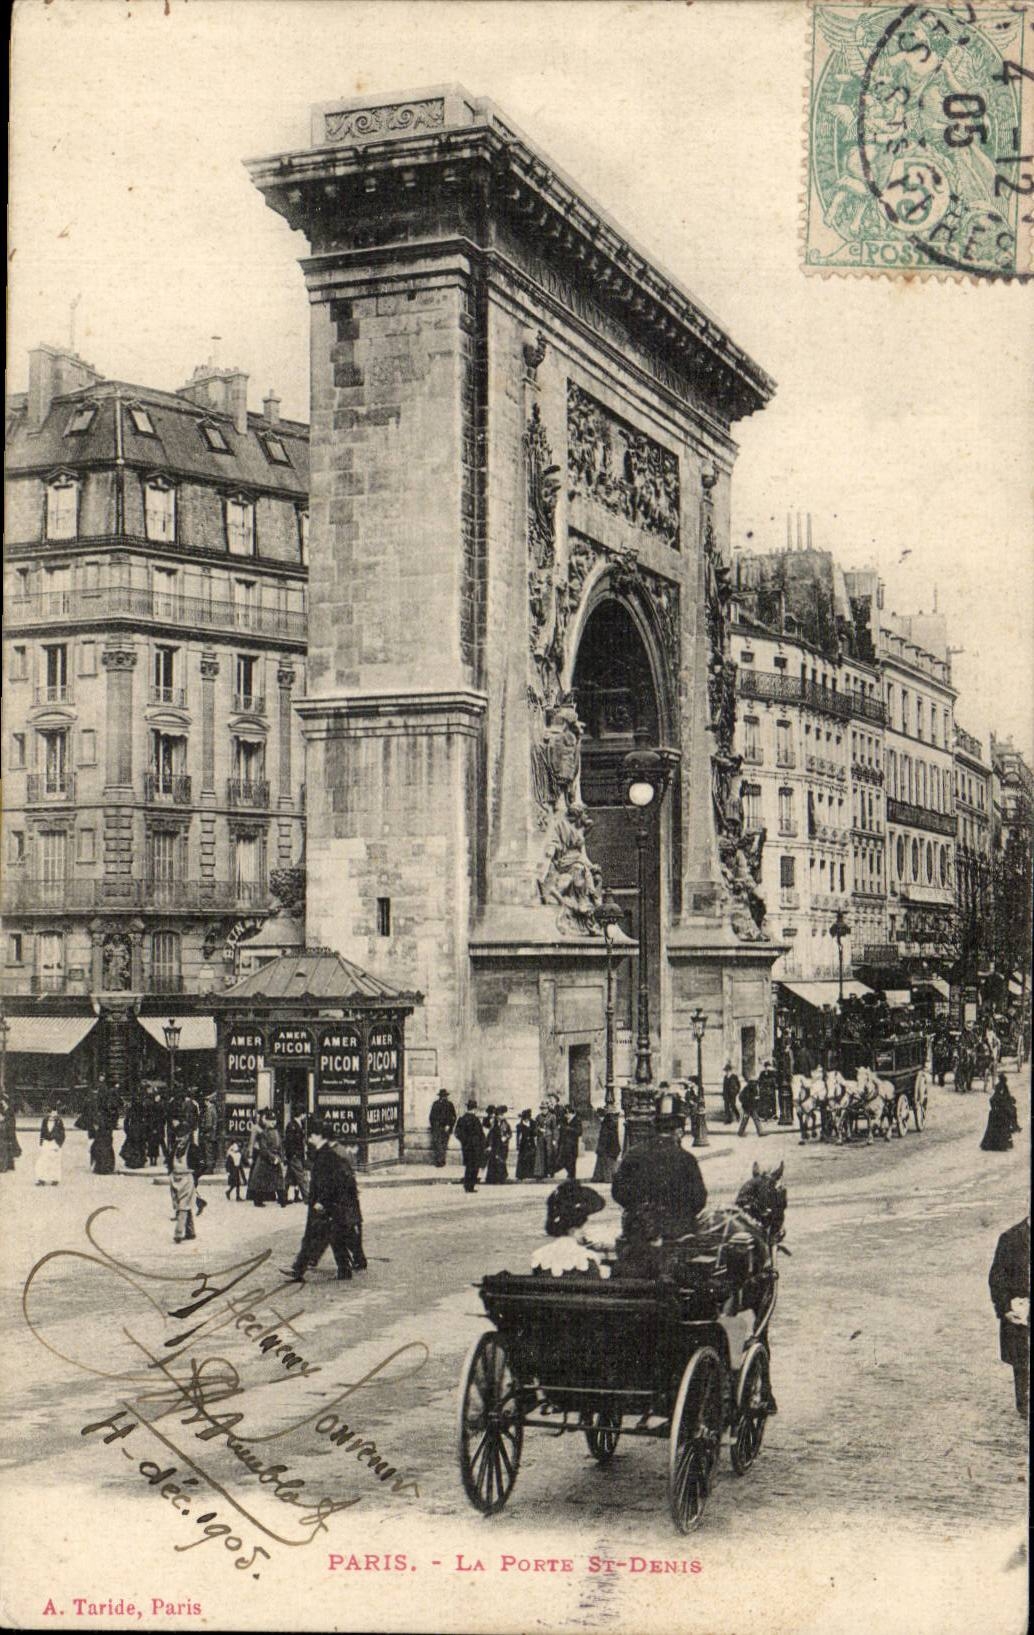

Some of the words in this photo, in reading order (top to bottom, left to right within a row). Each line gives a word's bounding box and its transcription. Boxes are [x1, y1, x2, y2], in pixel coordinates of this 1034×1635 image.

[942, 93, 987, 148] 05
[230, 1036, 262, 1047] AMER
[279, 1031, 307, 1040] AMER
[371, 1034, 393, 1046] AMER
[274, 1042, 312, 1054] PICON
[323, 1036, 357, 1048] AMER
[228, 1054, 265, 1071] PICON
[320, 1055, 360, 1072] PICON
[367, 1050, 398, 1072] PICON
[324, 1110, 354, 1120] AMER
[228, 1120, 253, 1132] PICO
